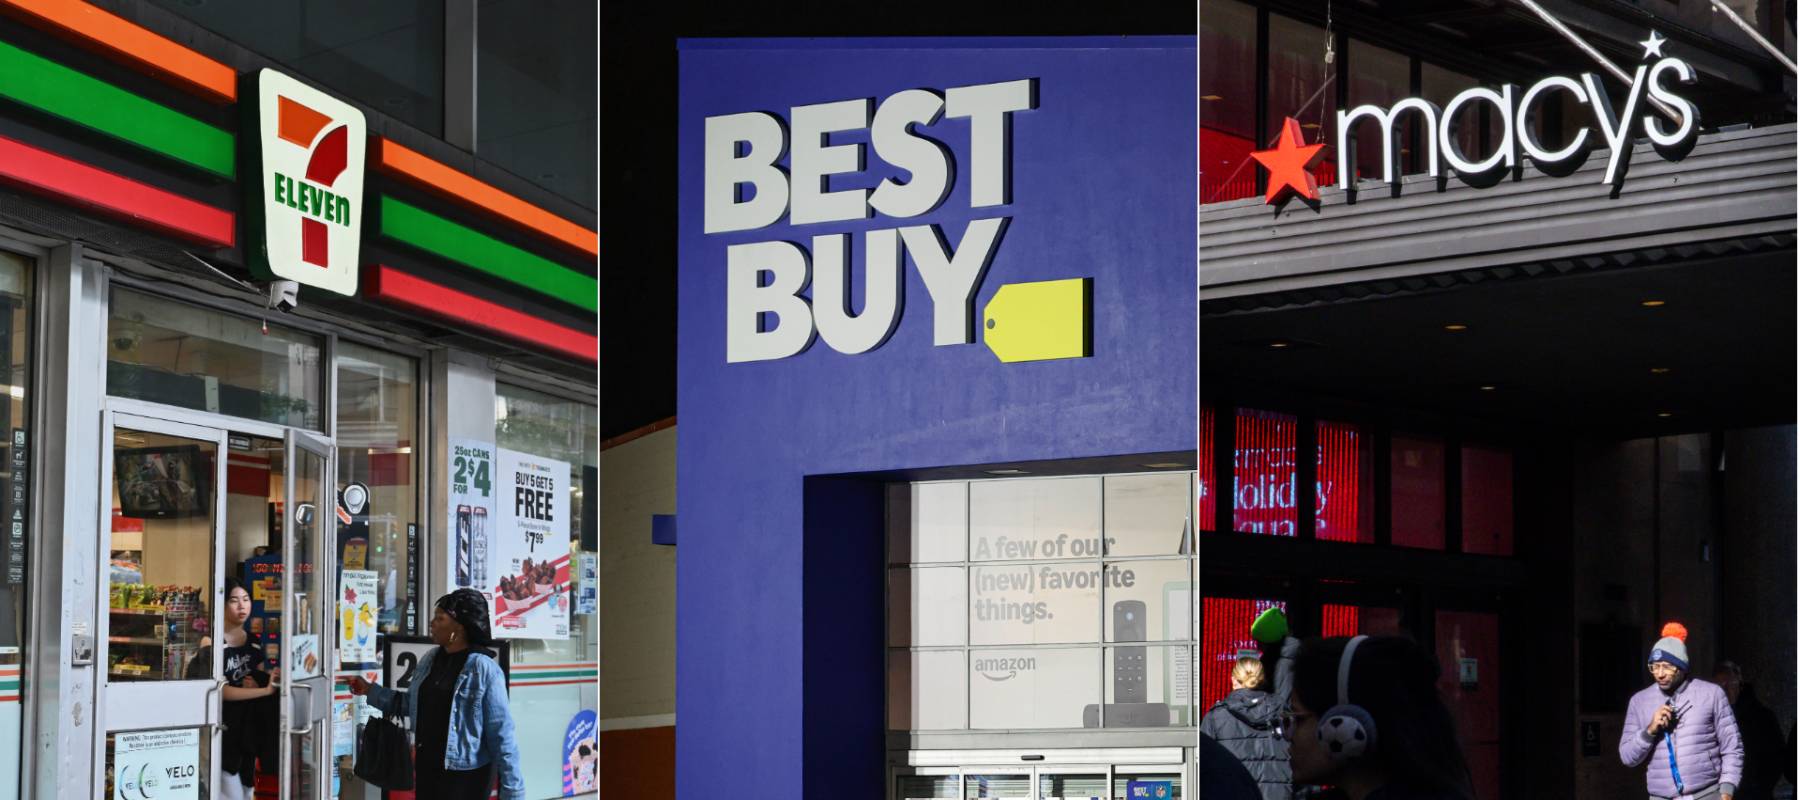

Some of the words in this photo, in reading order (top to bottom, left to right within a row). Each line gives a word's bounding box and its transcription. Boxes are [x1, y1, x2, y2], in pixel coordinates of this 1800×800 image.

[704, 78, 1036, 234] BEST
[277, 94, 348, 268] 7
[727, 216, 1012, 363] BUY
[454, 445, 471, 456] 25oz
[472, 448, 490, 460] CANS
[453, 484, 468, 494] FOR
[515, 471, 530, 486] BUY
[530, 474, 535, 488] 5
[535, 475, 549, 490] GET
[548, 478, 554, 491] 5
[515, 486, 554, 522] FREE
[975, 537, 991, 558] A
[995, 536, 1038, 558] few
[1041, 534, 1069, 557] of
[1070, 536, 1116, 557] our
[975, 566, 1035, 595] (new)
[1038, 565, 1136, 589] favorite
[975, 598, 1053, 624] things.
[975, 657, 1036, 673] amazon
[165, 764, 195, 778] VELO
